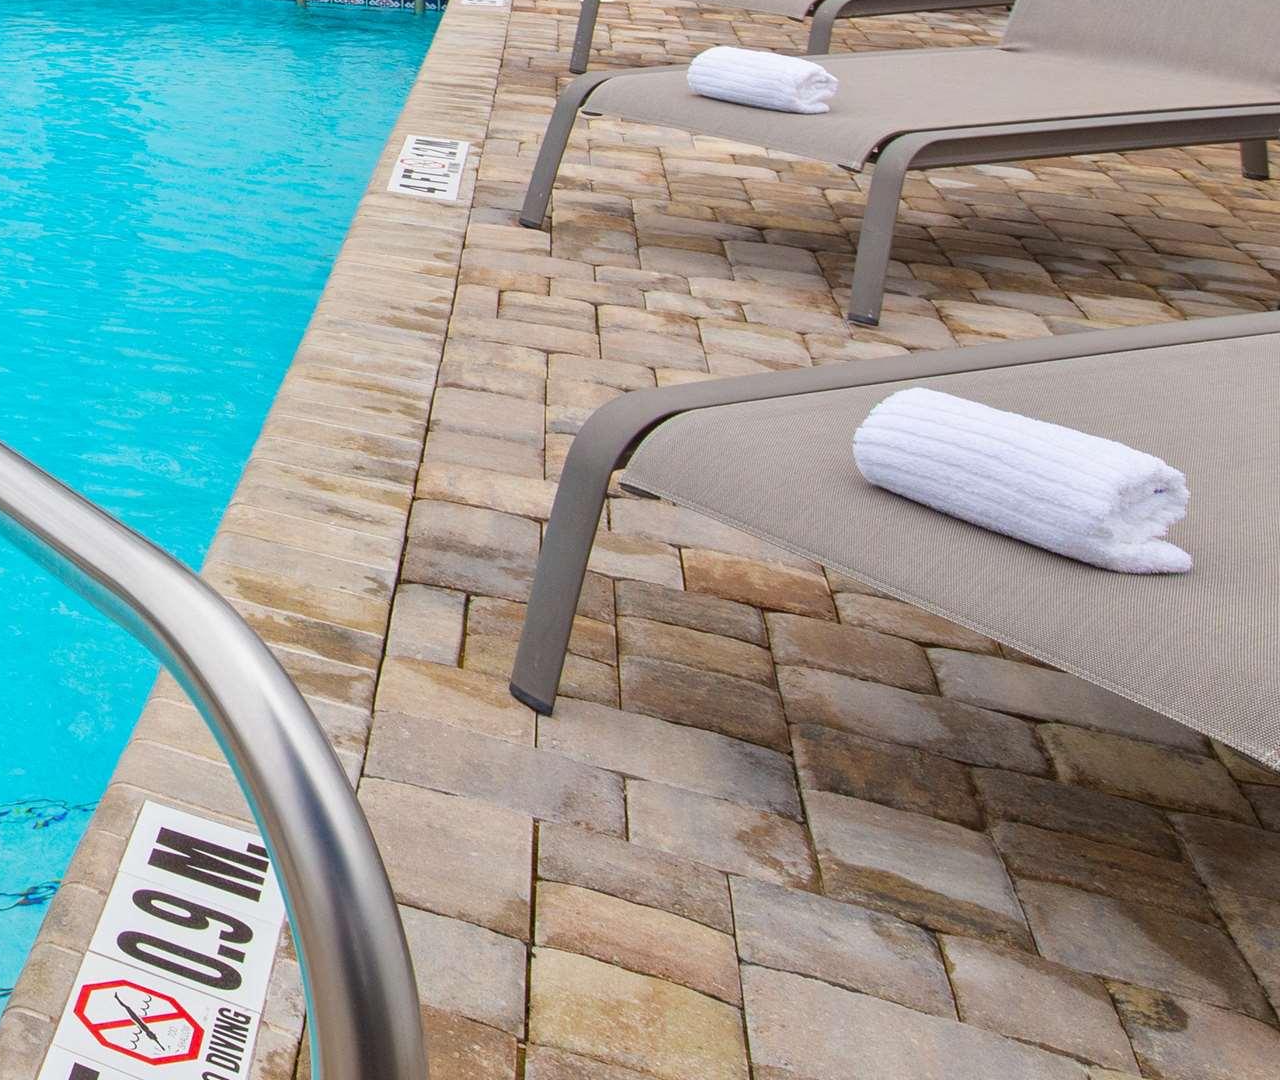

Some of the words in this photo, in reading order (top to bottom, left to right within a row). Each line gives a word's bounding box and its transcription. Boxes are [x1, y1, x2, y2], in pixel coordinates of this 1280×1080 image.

[147, 826, 270, 903] M.
[116, 888, 254, 991] 0.9
[205, 1007, 252, 1074] DIVING
